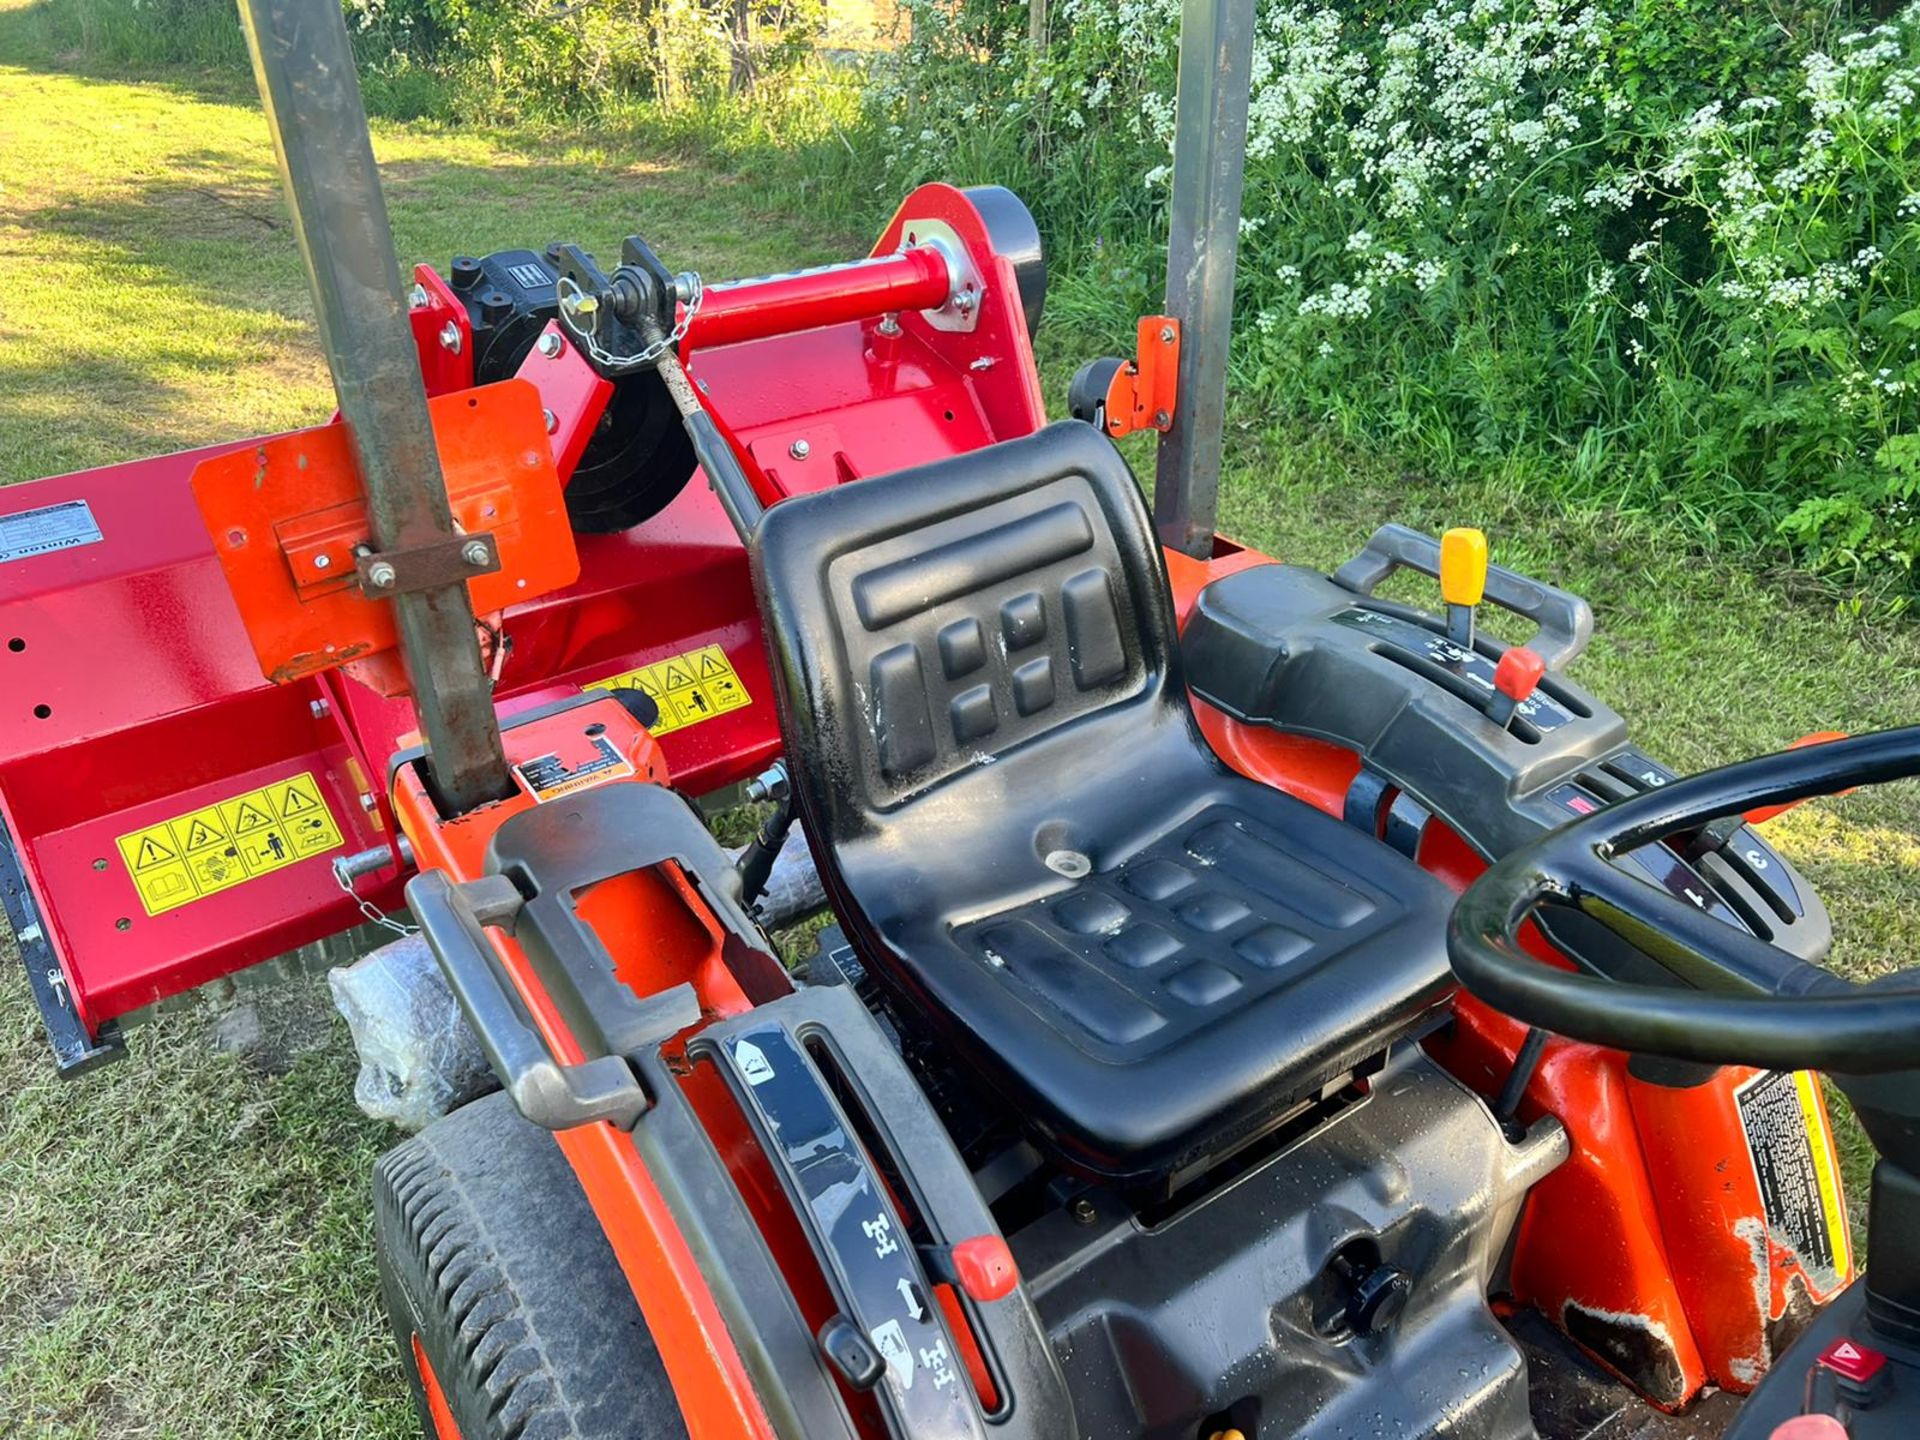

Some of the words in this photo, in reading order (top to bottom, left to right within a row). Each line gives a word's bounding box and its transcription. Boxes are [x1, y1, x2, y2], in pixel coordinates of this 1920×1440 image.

[18, 538, 80, 554] Winton
[1640, 770, 1666, 788] 2
[1746, 850, 1769, 869] 3
[1683, 887, 1704, 907] 1
[1811, 1127, 1836, 1226] CAUTION
